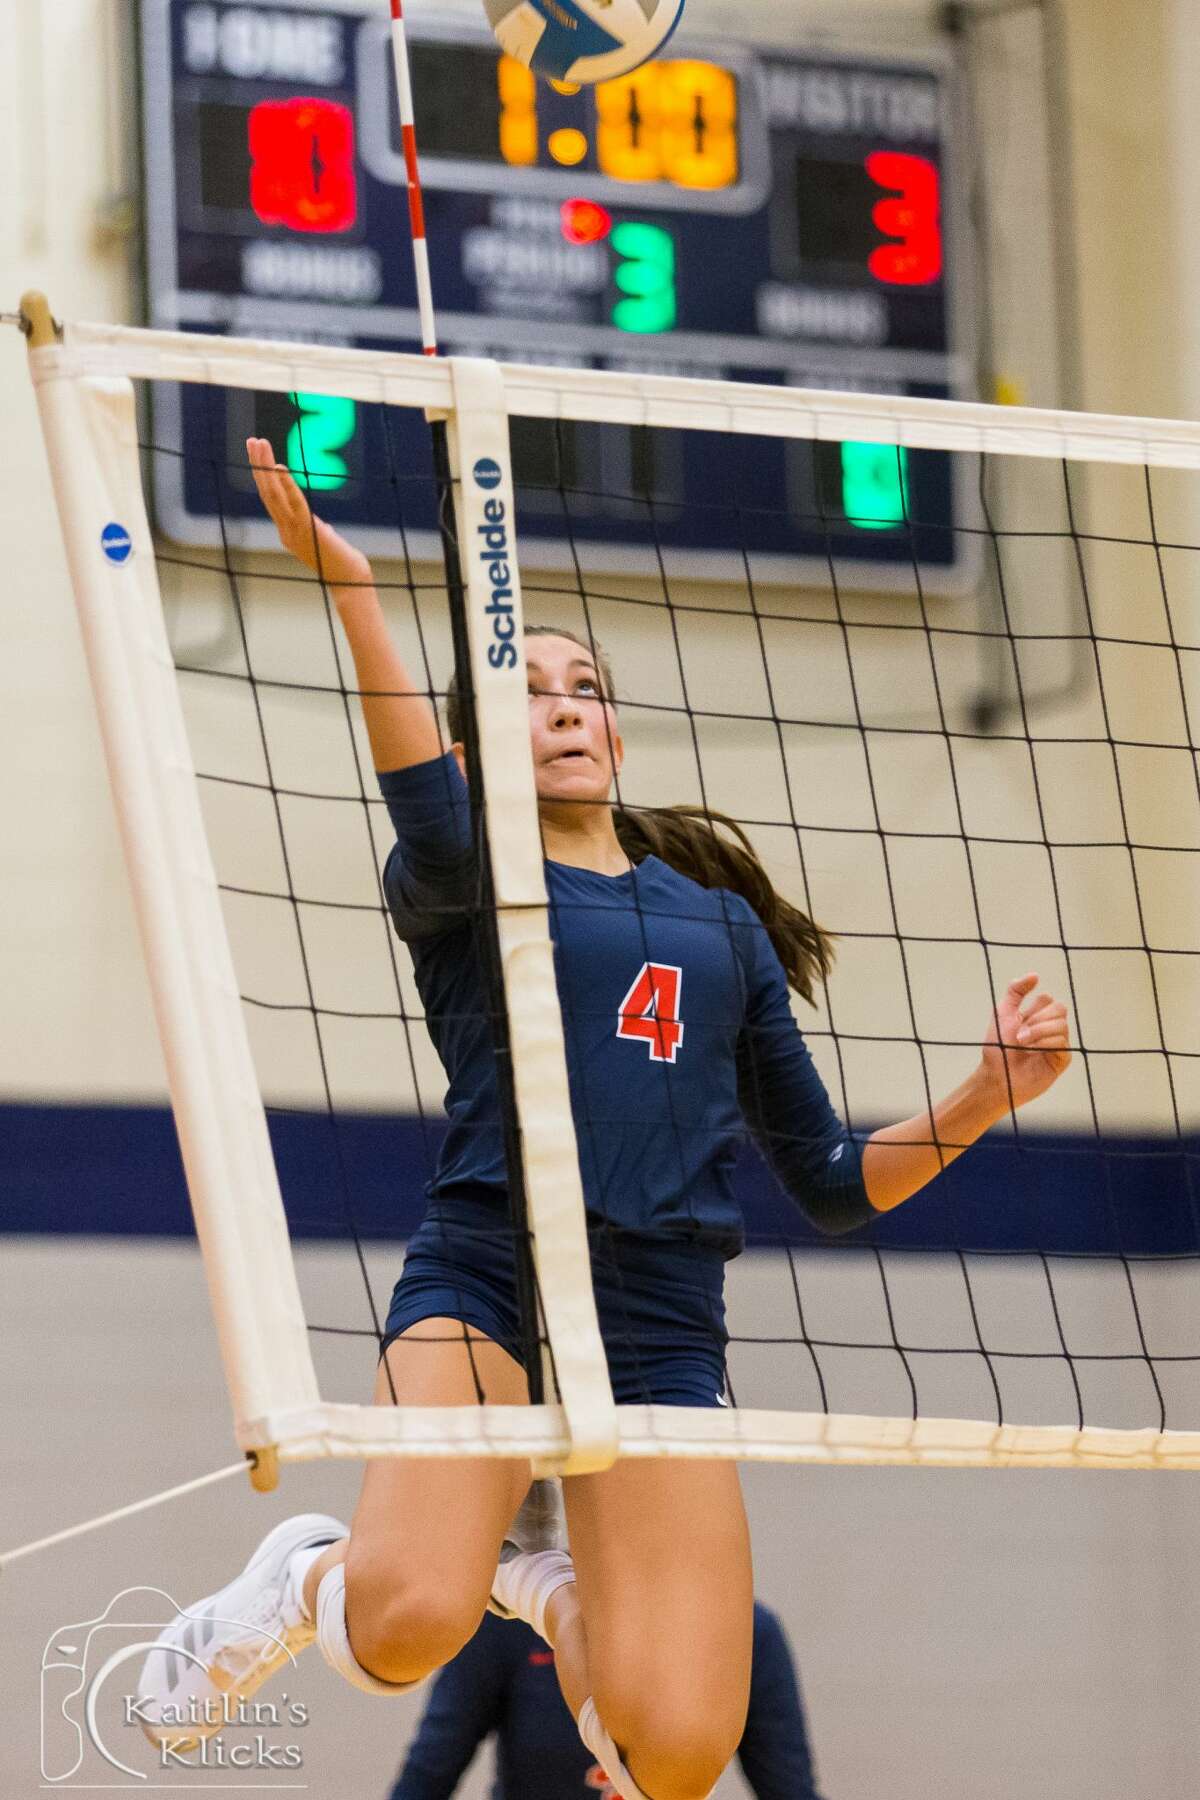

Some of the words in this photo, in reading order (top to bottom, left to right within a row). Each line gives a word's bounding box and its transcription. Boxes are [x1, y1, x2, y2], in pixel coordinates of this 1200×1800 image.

[610, 222, 676, 334] 3
[865, 151, 942, 286] 3
[477, 498, 518, 670] Schelde
[616, 961, 685, 1065] 4
